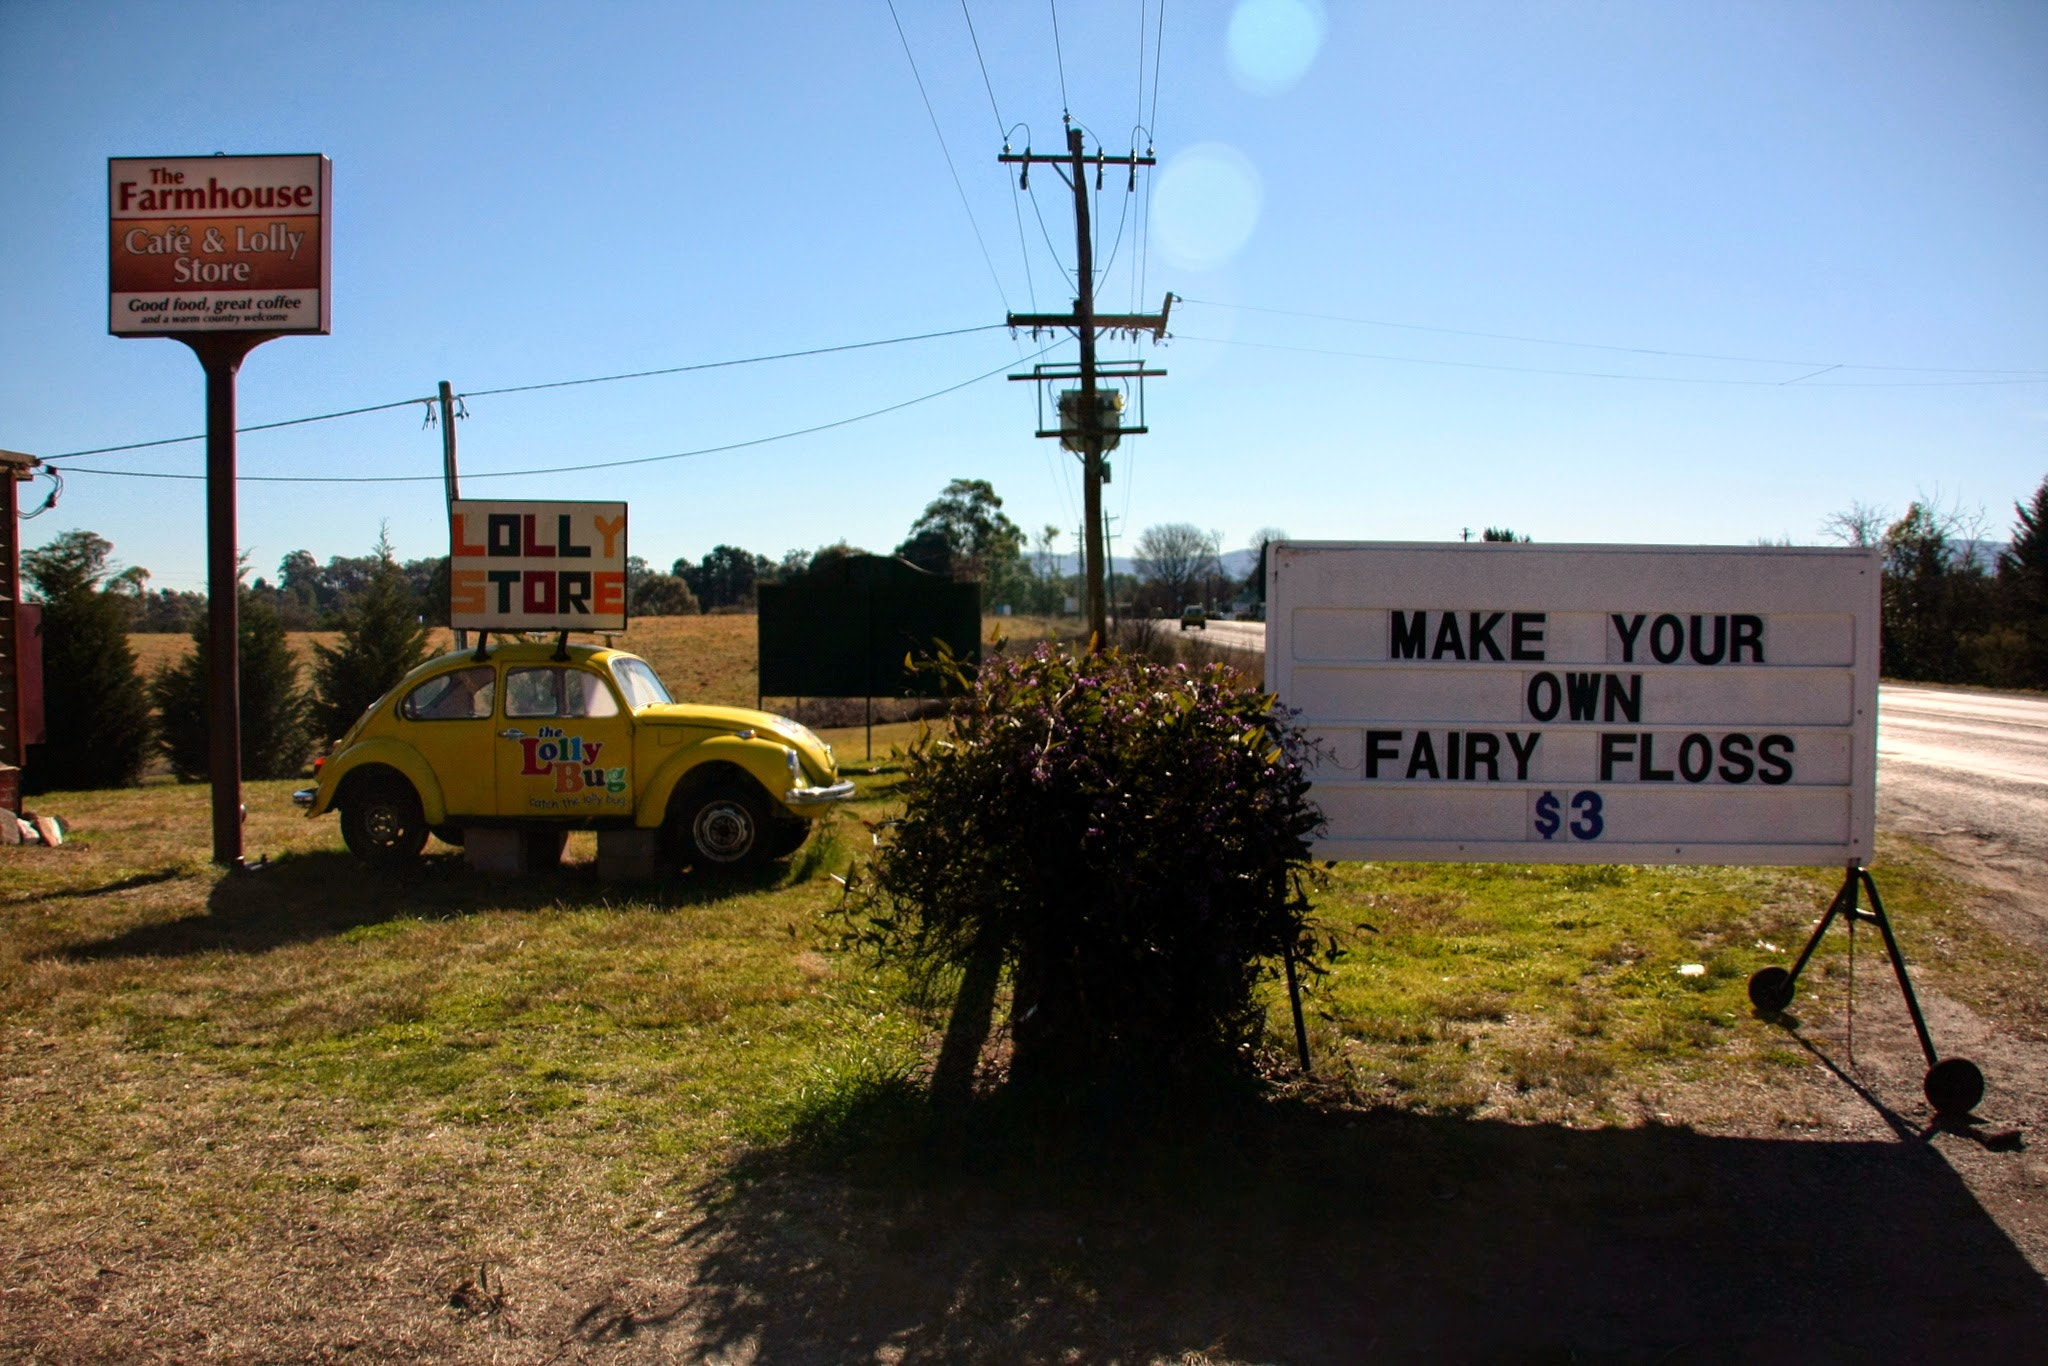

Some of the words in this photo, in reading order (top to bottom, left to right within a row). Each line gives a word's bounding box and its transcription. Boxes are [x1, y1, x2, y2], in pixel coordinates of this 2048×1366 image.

[119, 177, 313, 211] Farmhouse
[150, 167, 185, 185] The
[125, 225, 192, 255] Café
[202, 226, 226, 253] &
[236, 222, 304, 260] Lolly
[173, 257, 251, 283] Store
[128, 298, 168, 312] Good
[172, 296, 210, 312] food,
[213, 297, 252, 314] great
[256, 294, 302, 310] coffee
[141, 313, 160, 325] and
[163, 316, 170, 324] a
[172, 315, 200, 324] warm
[203, 313, 241, 326] country
[244, 312, 289, 323] welcome
[452, 514, 625, 558] LOLLY
[452, 570, 625, 614] STORE
[1390, 610, 1546, 661] MAKE
[1610, 613, 1765, 665] YOUR
[1526, 672, 1641, 722] OWN
[538, 726, 563, 738] the
[519, 736, 603, 776] Lolly
[1365, 731, 1541, 780] FAIRY
[1600, 733, 1795, 785] FLOSS
[553, 762, 627, 793] Bug
[1534, 790, 1604, 840] $3
